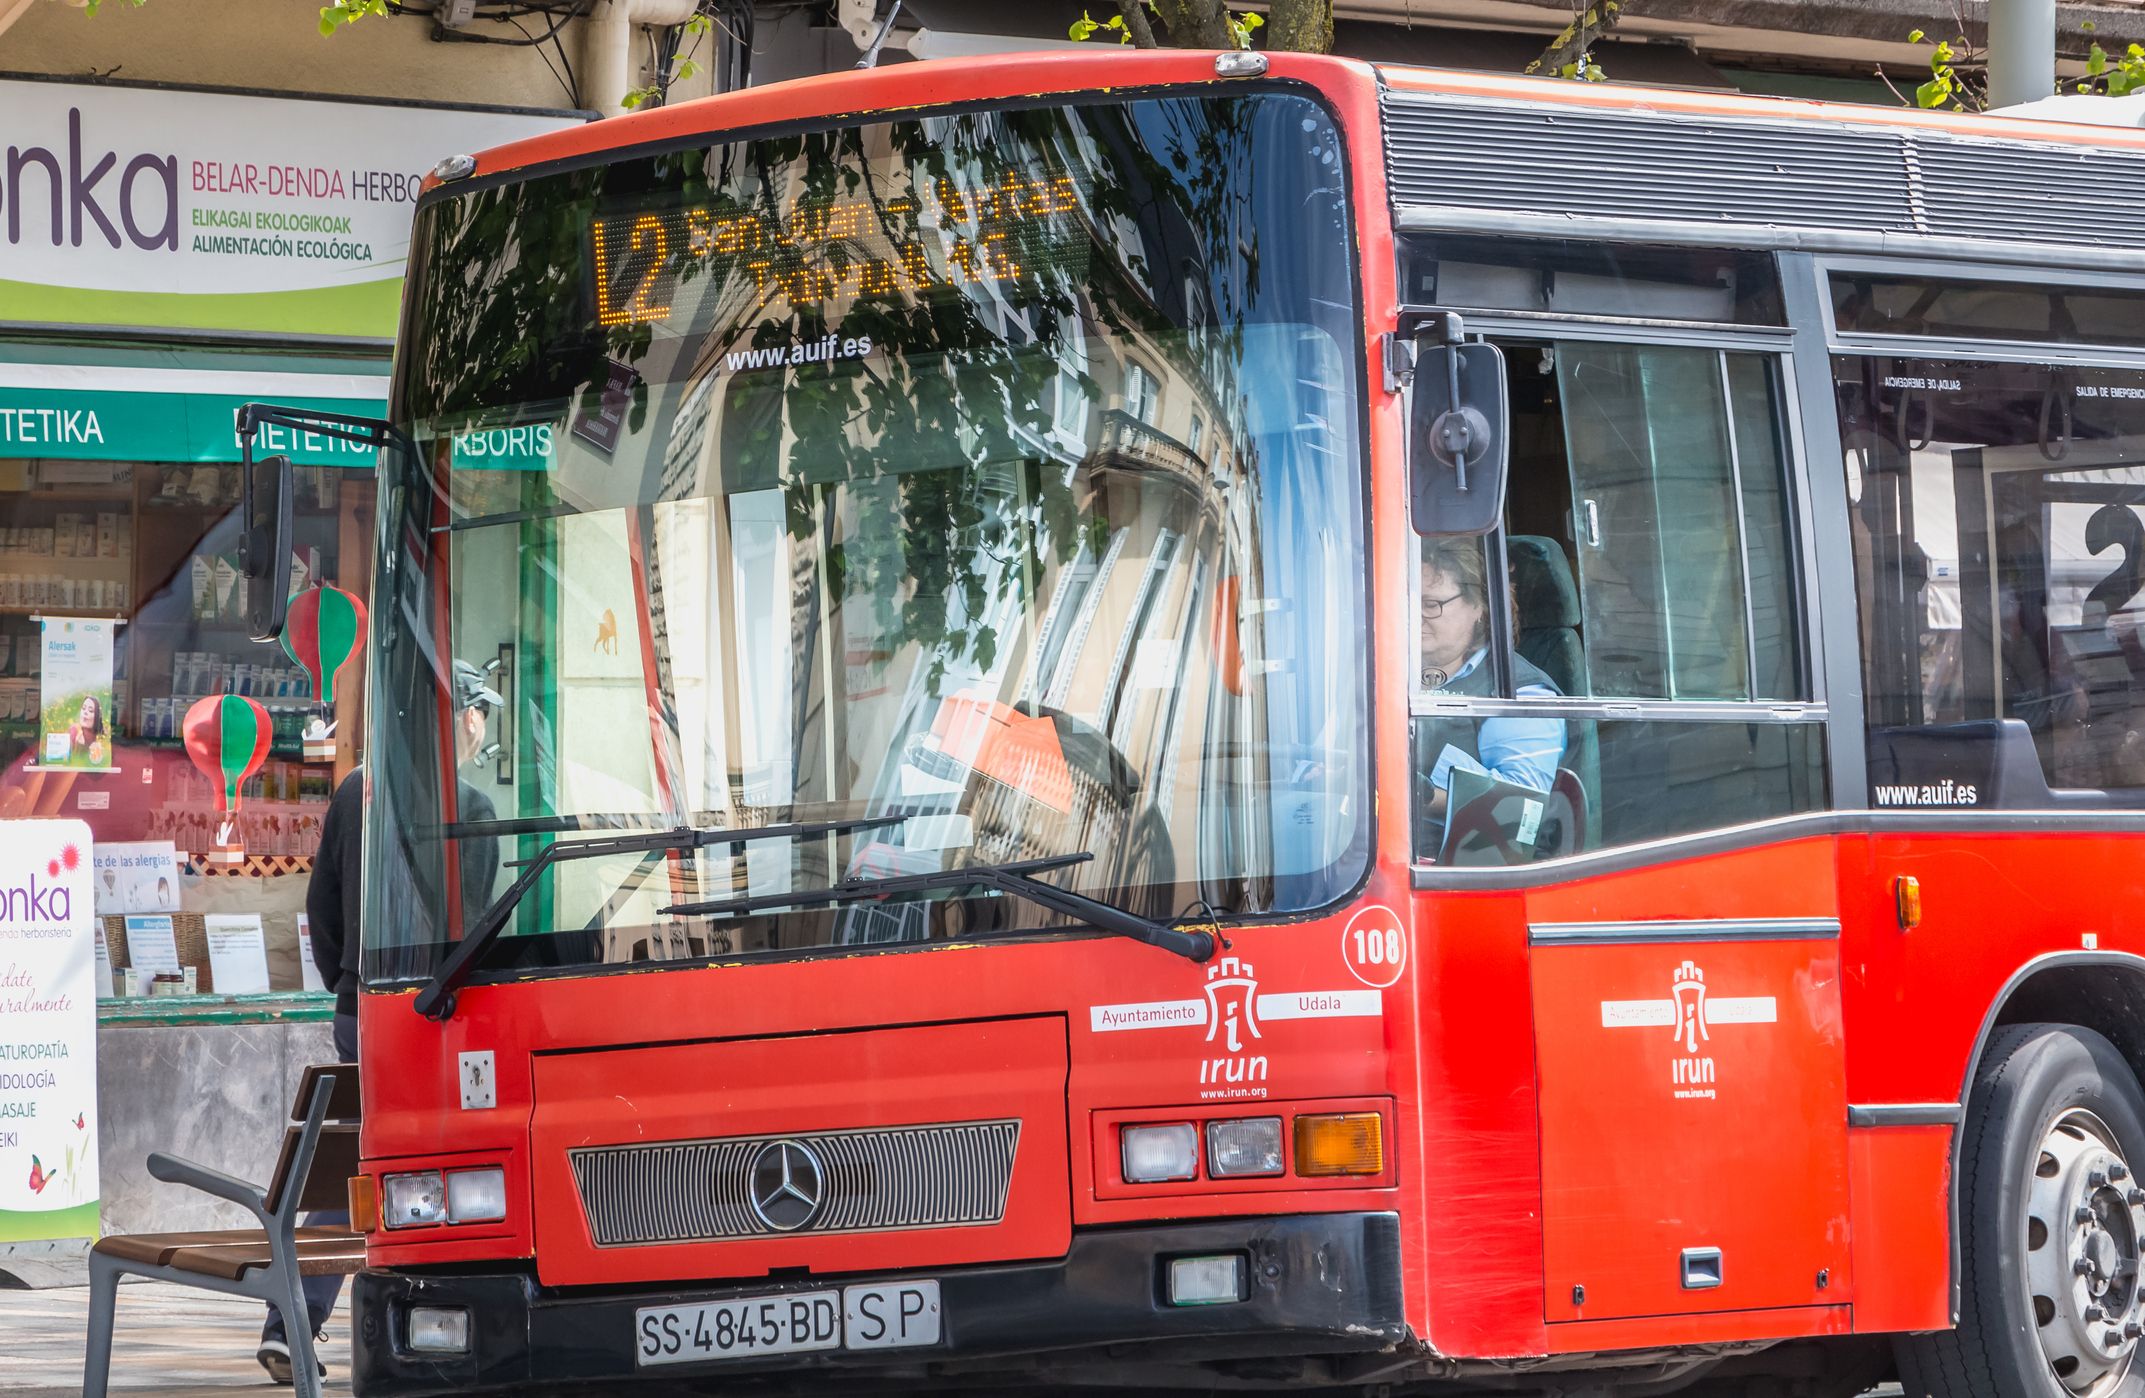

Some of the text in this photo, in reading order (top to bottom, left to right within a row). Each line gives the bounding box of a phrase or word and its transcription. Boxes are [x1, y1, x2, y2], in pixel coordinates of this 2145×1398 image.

[0, 106, 179, 252] nka
[192, 160, 346, 200] BELAR-DENDA
[192, 208, 352, 234] ELIKAGAI EKOLOGIKOAK
[687, 209, 762, 256] San
[775, 199, 874, 245] Juan
[925, 170, 1079, 224] Ventas
[192, 234, 372, 261] ALIMENTACIÓN ECOLÓGICA
[593, 215, 671, 326] L2
[725, 333, 873, 372] www.auif.es
[2076, 386, 2098, 397] SALIDA
[2099, 386, 2109, 398] DE
[0, 408, 105, 444] TETIKA
[1875, 780, 1977, 806] www.auif.es
[105, 854, 117, 867] de
[120, 854, 133, 867] las
[135, 853, 171, 869] alergias
[21, 927, 72, 939] herboristeria
[1353, 929, 1400, 965] 108
[1101, 1005, 1196, 1026] Ayuntamiento
[1298, 995, 1342, 1011] Udala
[1199, 1055, 1268, 1084] irun
[1672, 1057, 1716, 1084] irun
[1200, 1087, 1268, 1099] www.irun.org
[1674, 1087, 1716, 1100] www.irun.org
[0, 1101, 37, 1119] ASAJE
